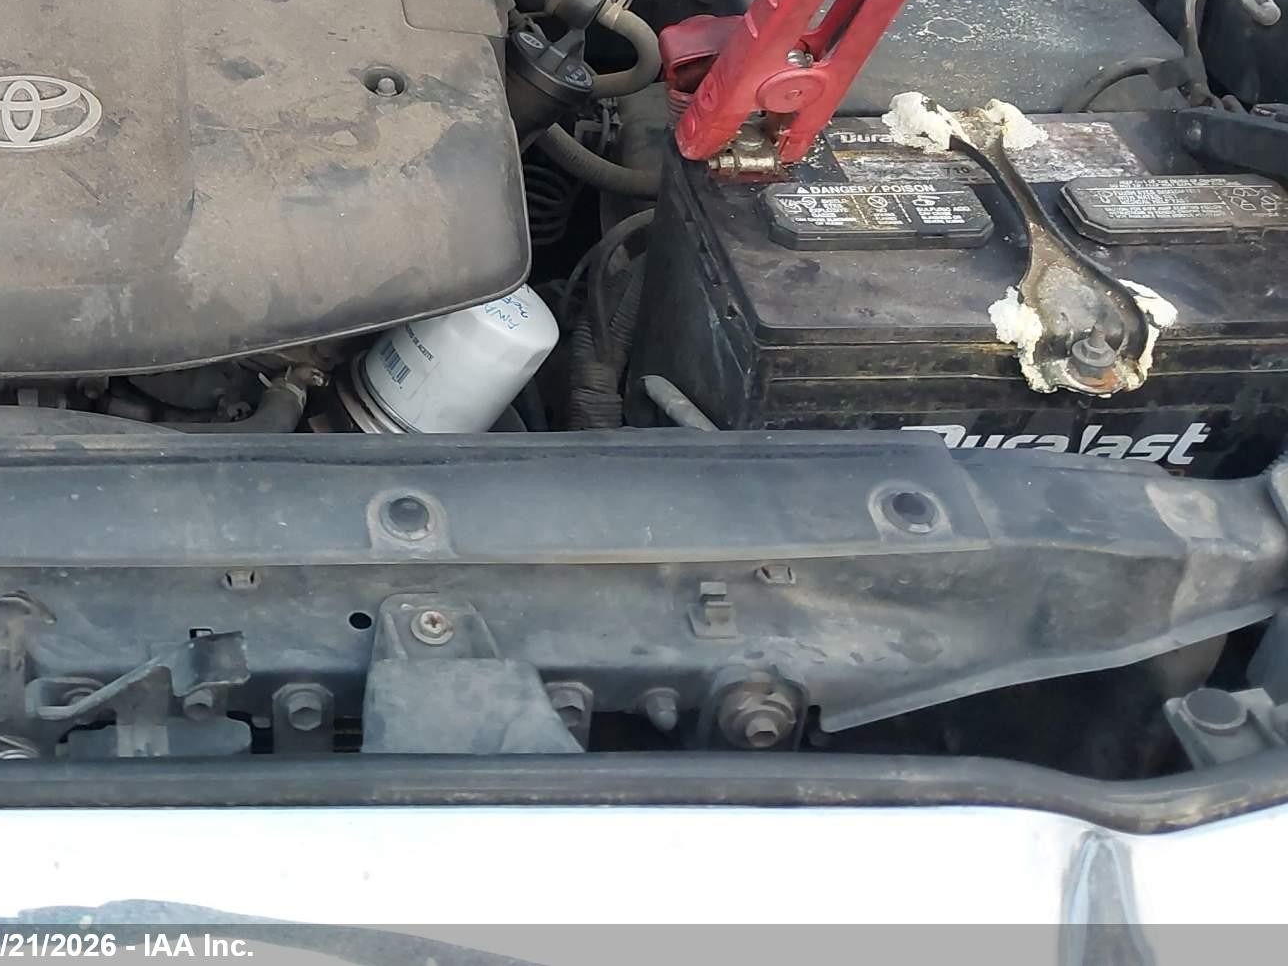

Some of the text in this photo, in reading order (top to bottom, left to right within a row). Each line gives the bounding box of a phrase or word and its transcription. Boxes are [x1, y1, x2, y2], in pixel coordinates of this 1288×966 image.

[839, 131, 894, 144] Dura
[809, 186, 867, 194] DANGER
[881, 184, 936, 193] POISON
